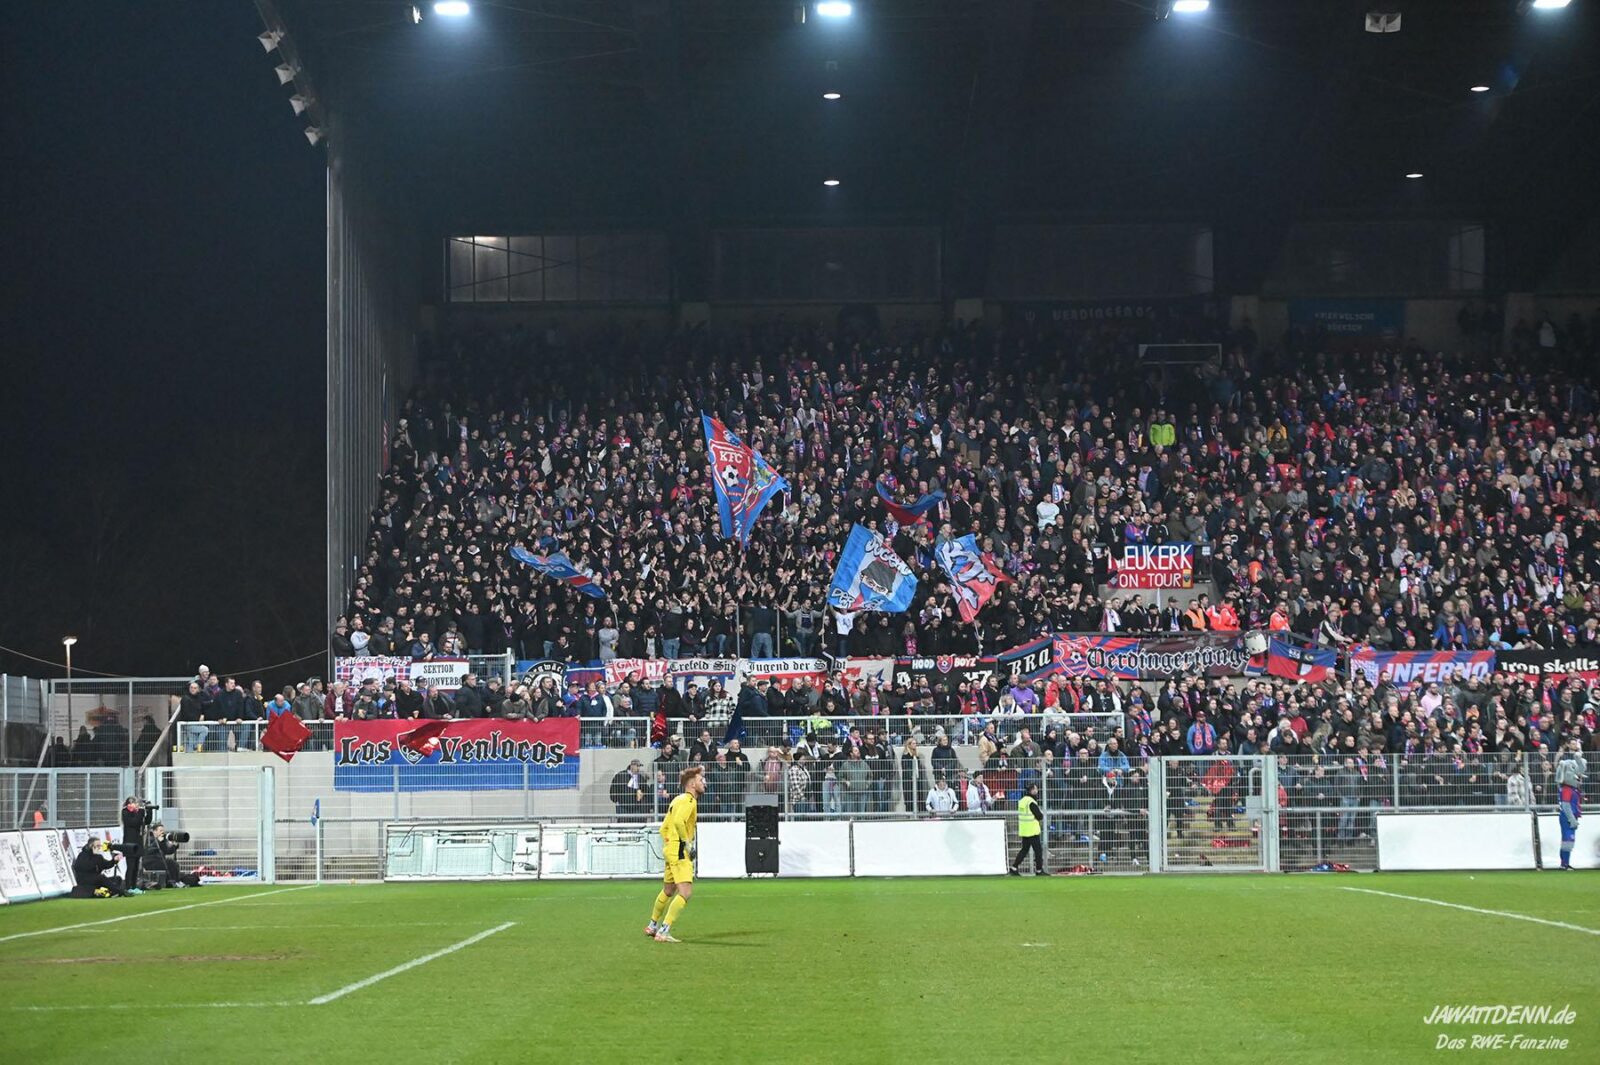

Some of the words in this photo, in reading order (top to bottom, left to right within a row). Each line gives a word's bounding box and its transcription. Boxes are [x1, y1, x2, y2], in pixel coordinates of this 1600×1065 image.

[719, 451, 743, 464] KFC
[1119, 573, 1139, 588] ON
[1147, 573, 1182, 587] TOUR
[423, 664, 454, 674] SEKTION
[670, 659, 704, 673] Crefeld
[748, 661, 789, 674] Jugend
[793, 661, 810, 671] der
[814, 659, 846, 670] Sdt
[912, 659, 935, 670] HOOD
[954, 657, 977, 668] BOYZ
[1386, 661, 1489, 683] INFERNO
[338, 737, 391, 766] Los
[438, 730, 567, 768] Venlocos
